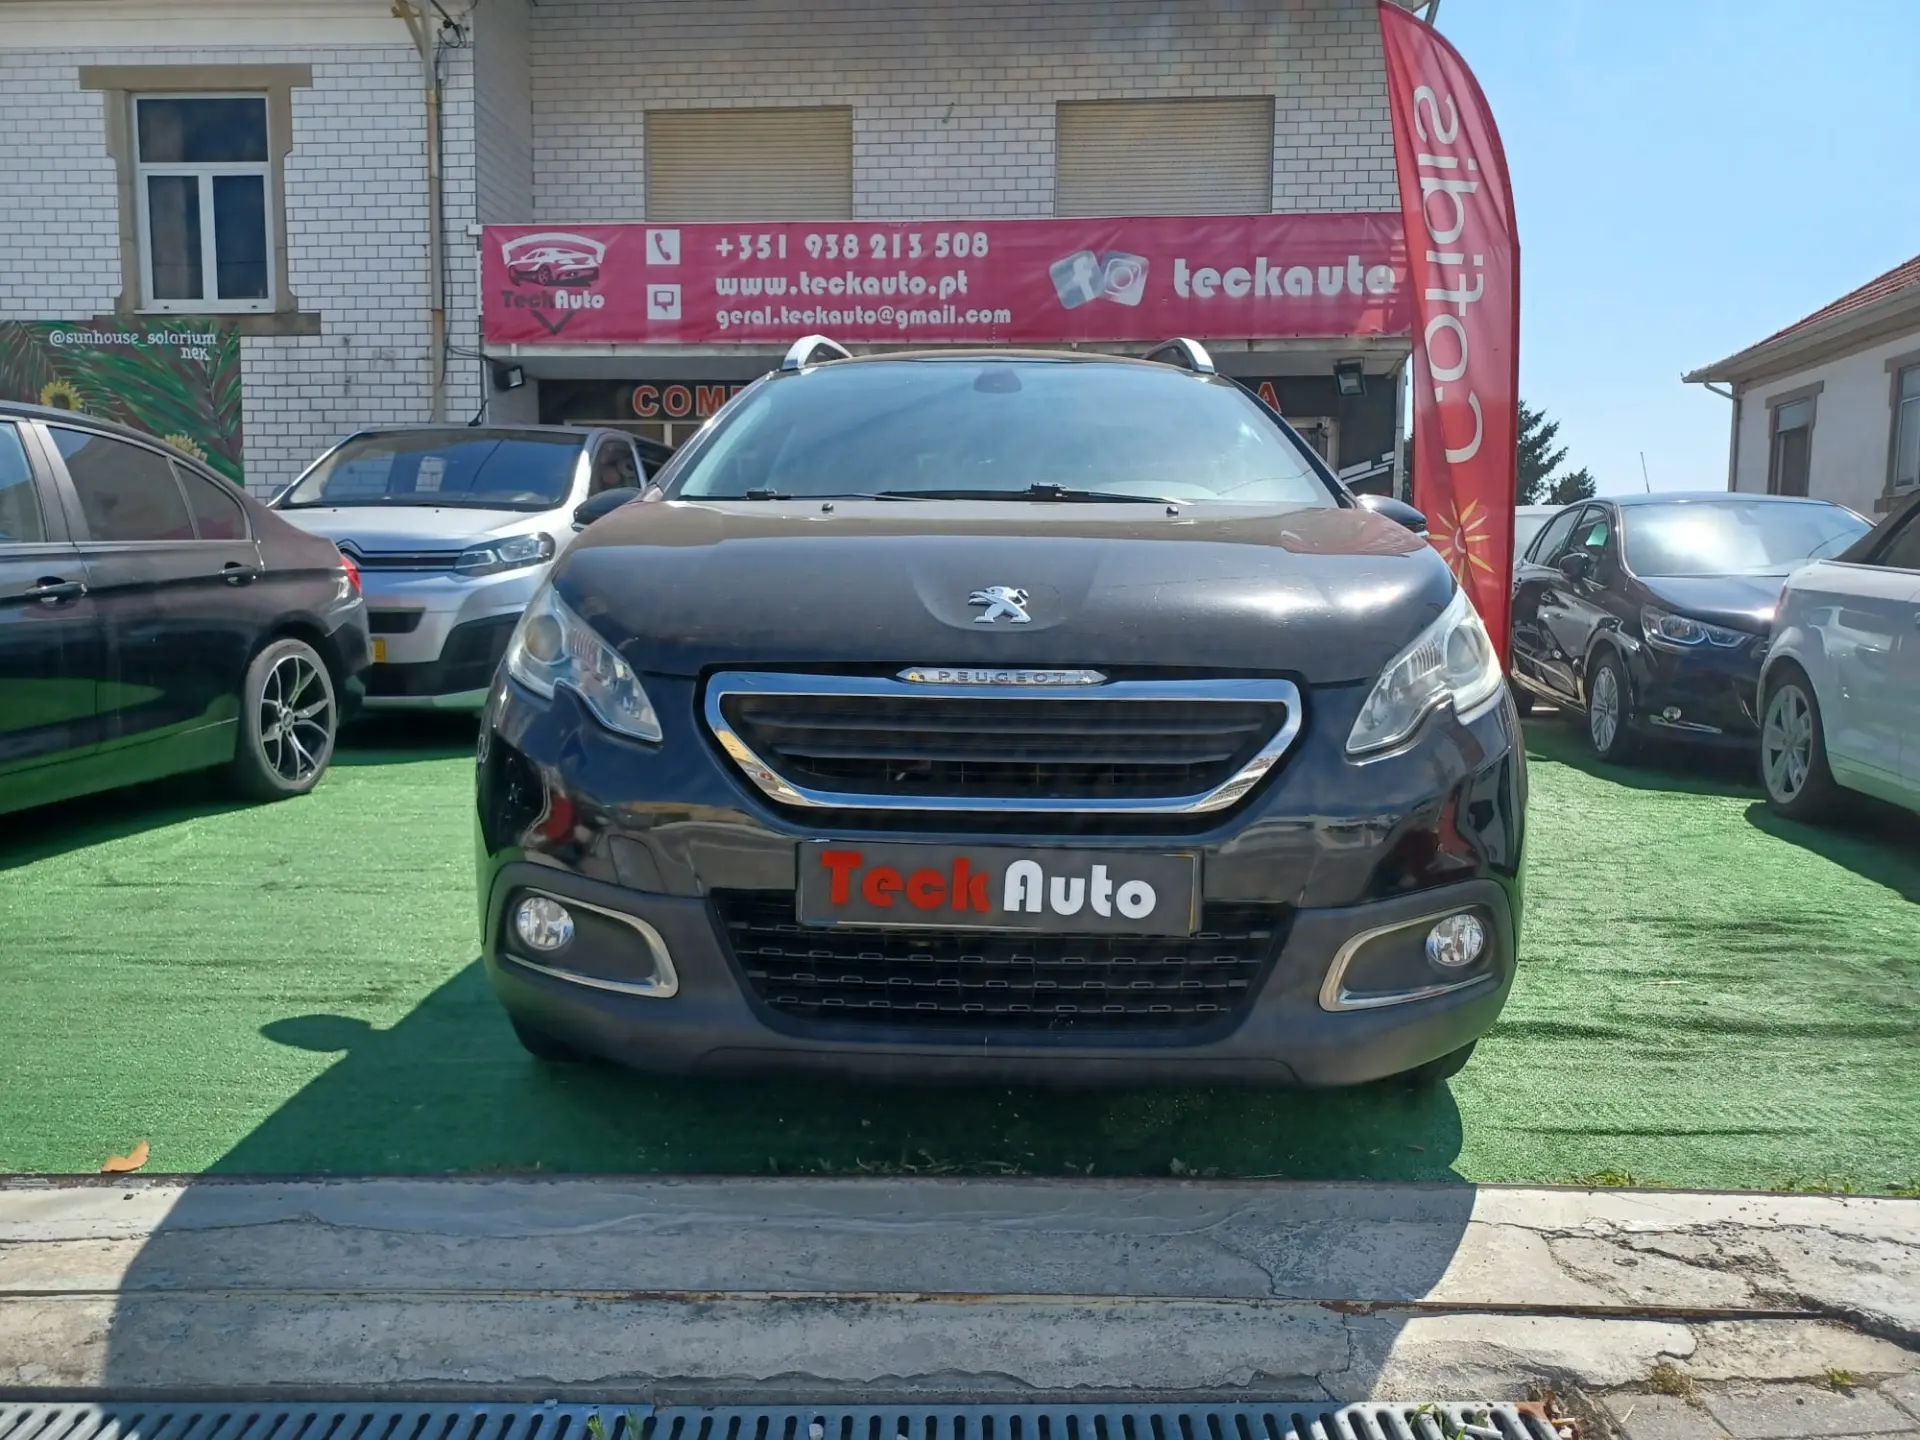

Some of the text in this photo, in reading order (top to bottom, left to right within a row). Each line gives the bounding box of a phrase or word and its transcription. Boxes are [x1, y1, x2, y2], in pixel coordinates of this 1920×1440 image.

[715, 231, 989, 261] +351 938 213 508
[715, 270, 968, 300] www.teckauto.pt
[1173, 255, 1396, 299] teckauto
[716, 304, 1012, 330] geral.teckauto@gmail.com
[49, 329, 218, 347] @sunhouse_solarium
[632, 384, 746, 418] COM
[938, 670, 1067, 684] PEUGEOT
[820, 850, 1157, 919] Teck Auto
